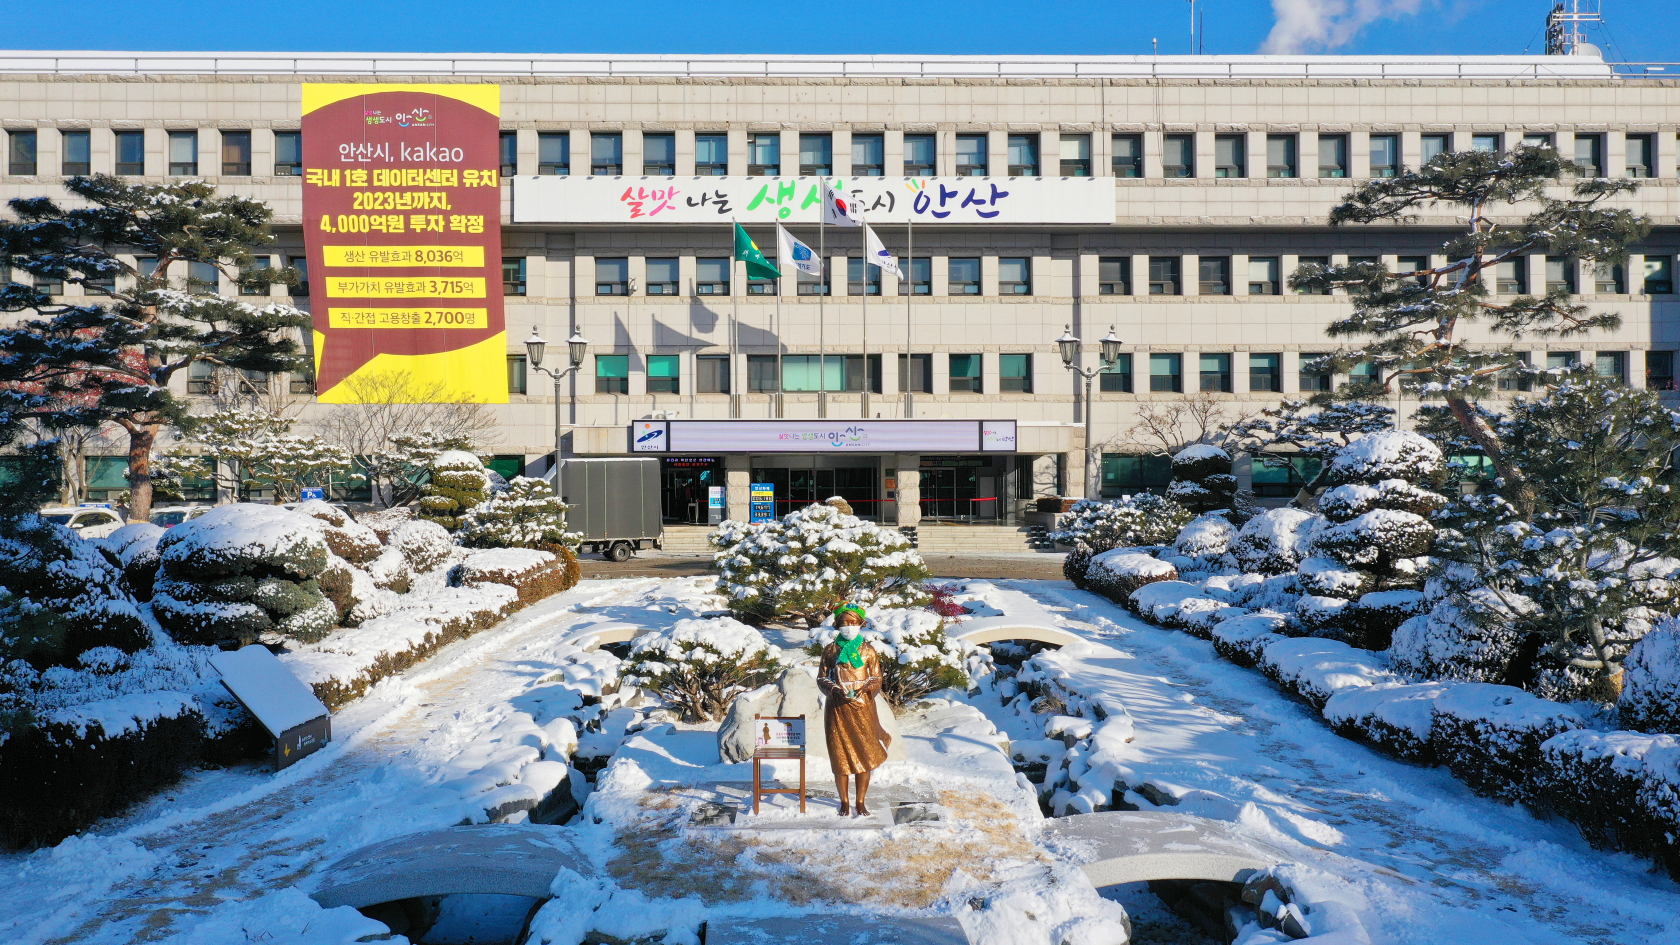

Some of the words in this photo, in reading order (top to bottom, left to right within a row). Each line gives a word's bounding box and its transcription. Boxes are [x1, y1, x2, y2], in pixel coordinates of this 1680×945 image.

[366, 116, 392, 125] 생생도시
[339, 142, 394, 163] 안산시,
[401, 142, 464, 162] kakao
[306, 168, 341, 187] 국내
[344, 168, 368, 187] 1호
[373, 168, 459, 187] 데이터센터
[463, 169, 498, 187] 유치
[353, 191, 452, 210] 2023년까지,
[912, 181, 1009, 219] 안산
[320, 214, 405, 233] 4,000억원
[410, 214, 445, 233] 투자
[449, 214, 484, 233] 확정
[344, 250, 366, 263] 생산
[369, 250, 412, 263] 유발효과
[415, 249, 464, 264] 8,036억
[338, 281, 381, 294] 부가가치
[384, 281, 427, 294] 유발효과
[429, 280, 475, 295] 3,715억
[340, 312, 376, 325] 직·간접
[379, 312, 422, 325] 고용창출
[424, 311, 476, 326] 2,700명
[802, 432, 826, 441] 생생도시
